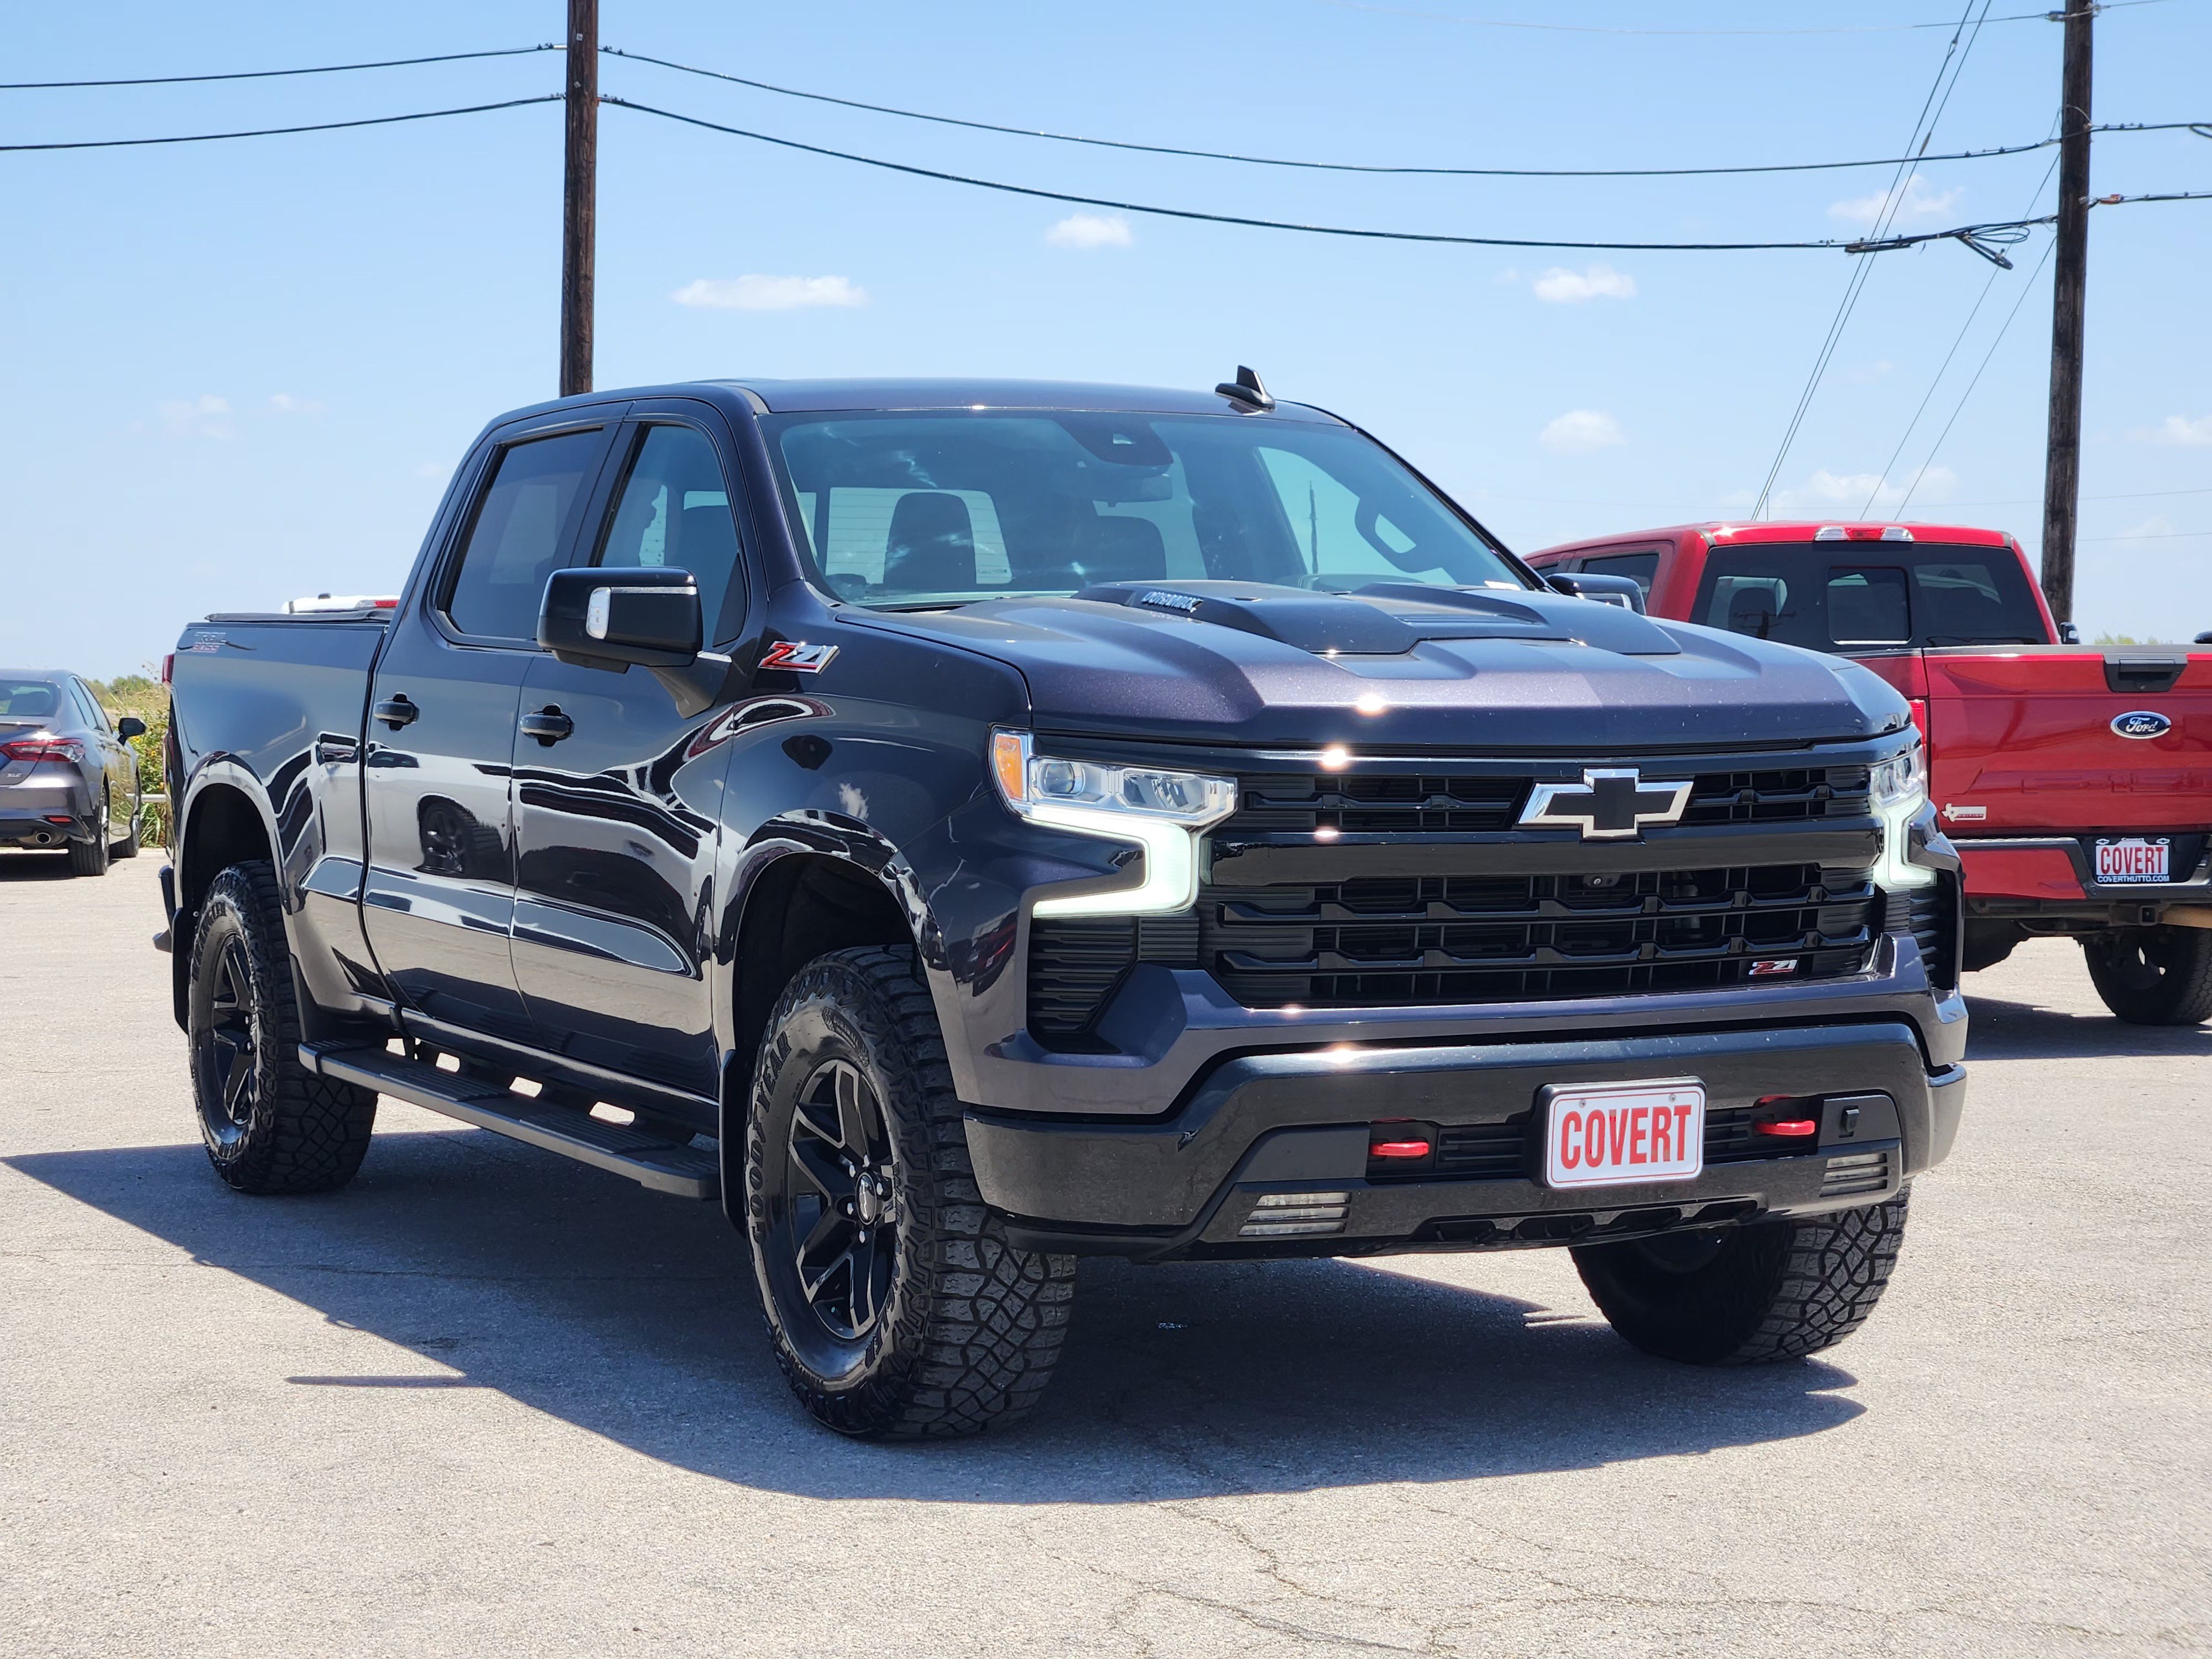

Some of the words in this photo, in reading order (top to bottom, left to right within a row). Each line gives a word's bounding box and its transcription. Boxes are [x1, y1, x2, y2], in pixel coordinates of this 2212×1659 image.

[191, 644, 219, 653] BOSS
[195, 632, 226, 645] TRAIL
[758, 640, 841, 675] Z71
[2126, 717, 2158, 732] Ford
[2101, 846, 2164, 874] COVERT
[1749, 959, 1797, 975] Z71
[749, 1031, 792, 1245] GOODYEAR
[1561, 1104, 1692, 1169] COVERT
